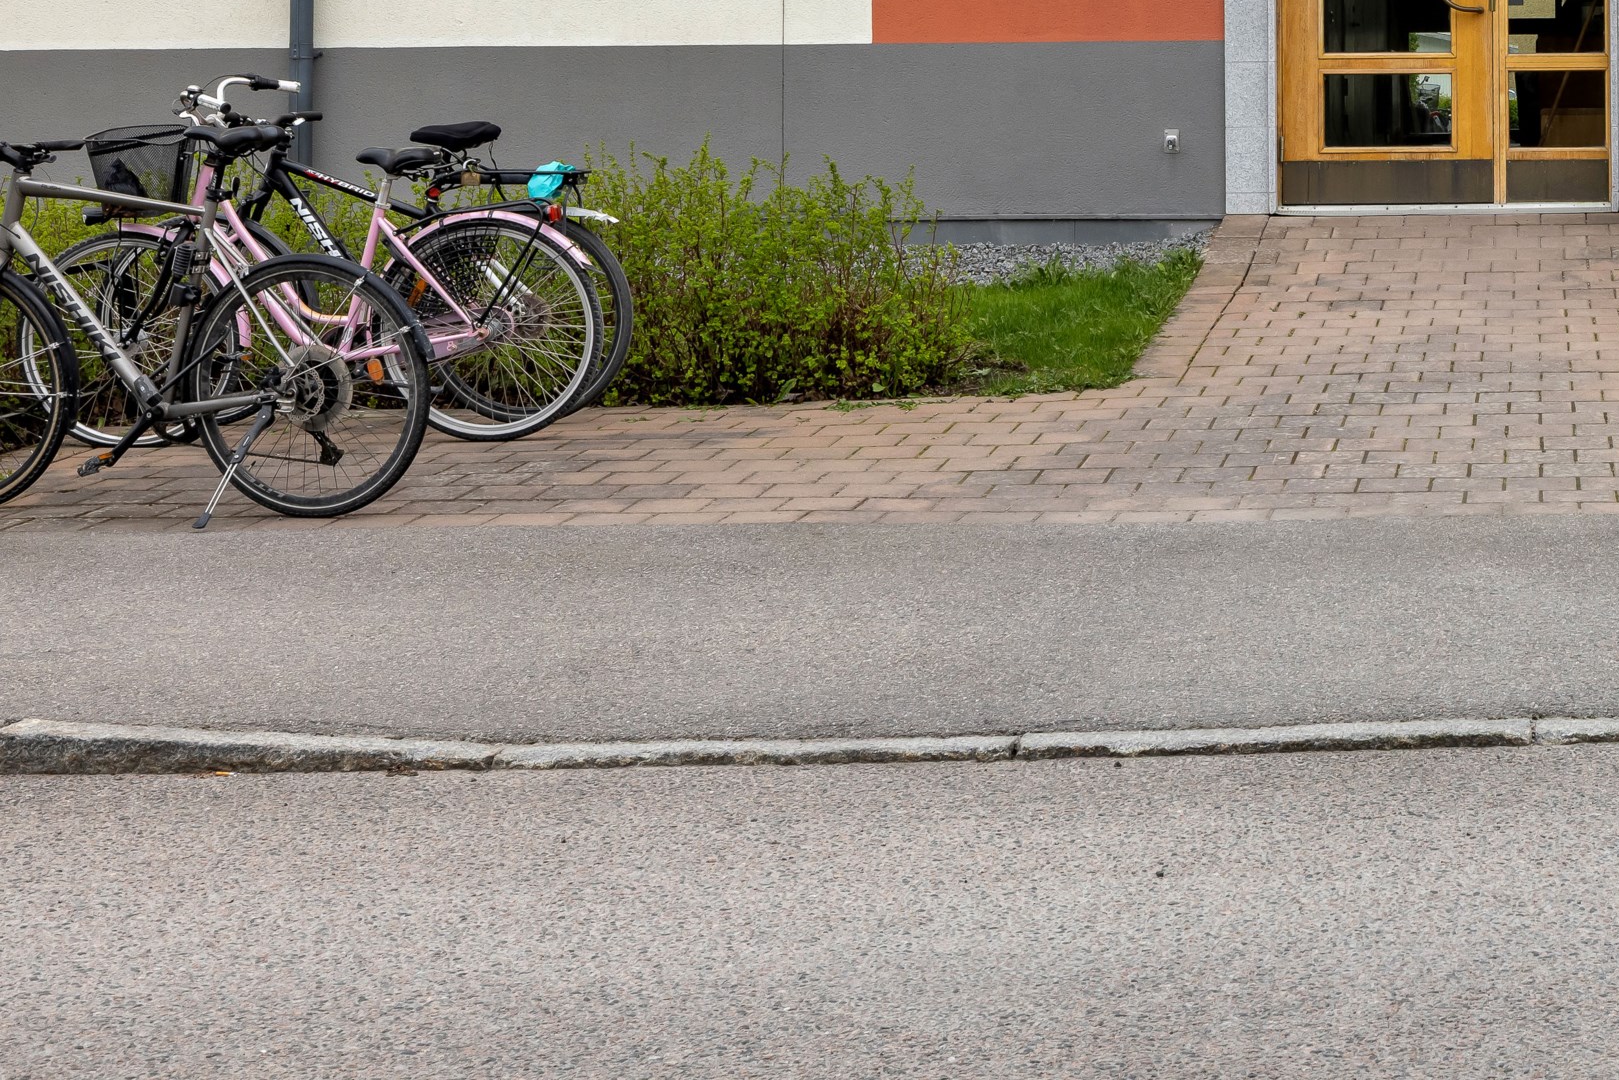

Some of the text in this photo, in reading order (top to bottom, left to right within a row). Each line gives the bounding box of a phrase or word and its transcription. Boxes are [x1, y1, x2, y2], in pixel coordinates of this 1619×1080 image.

[316, 171, 376, 198] HYBRID
[289, 197, 345, 259] NISH
[25, 253, 121, 360] NISHIKI
